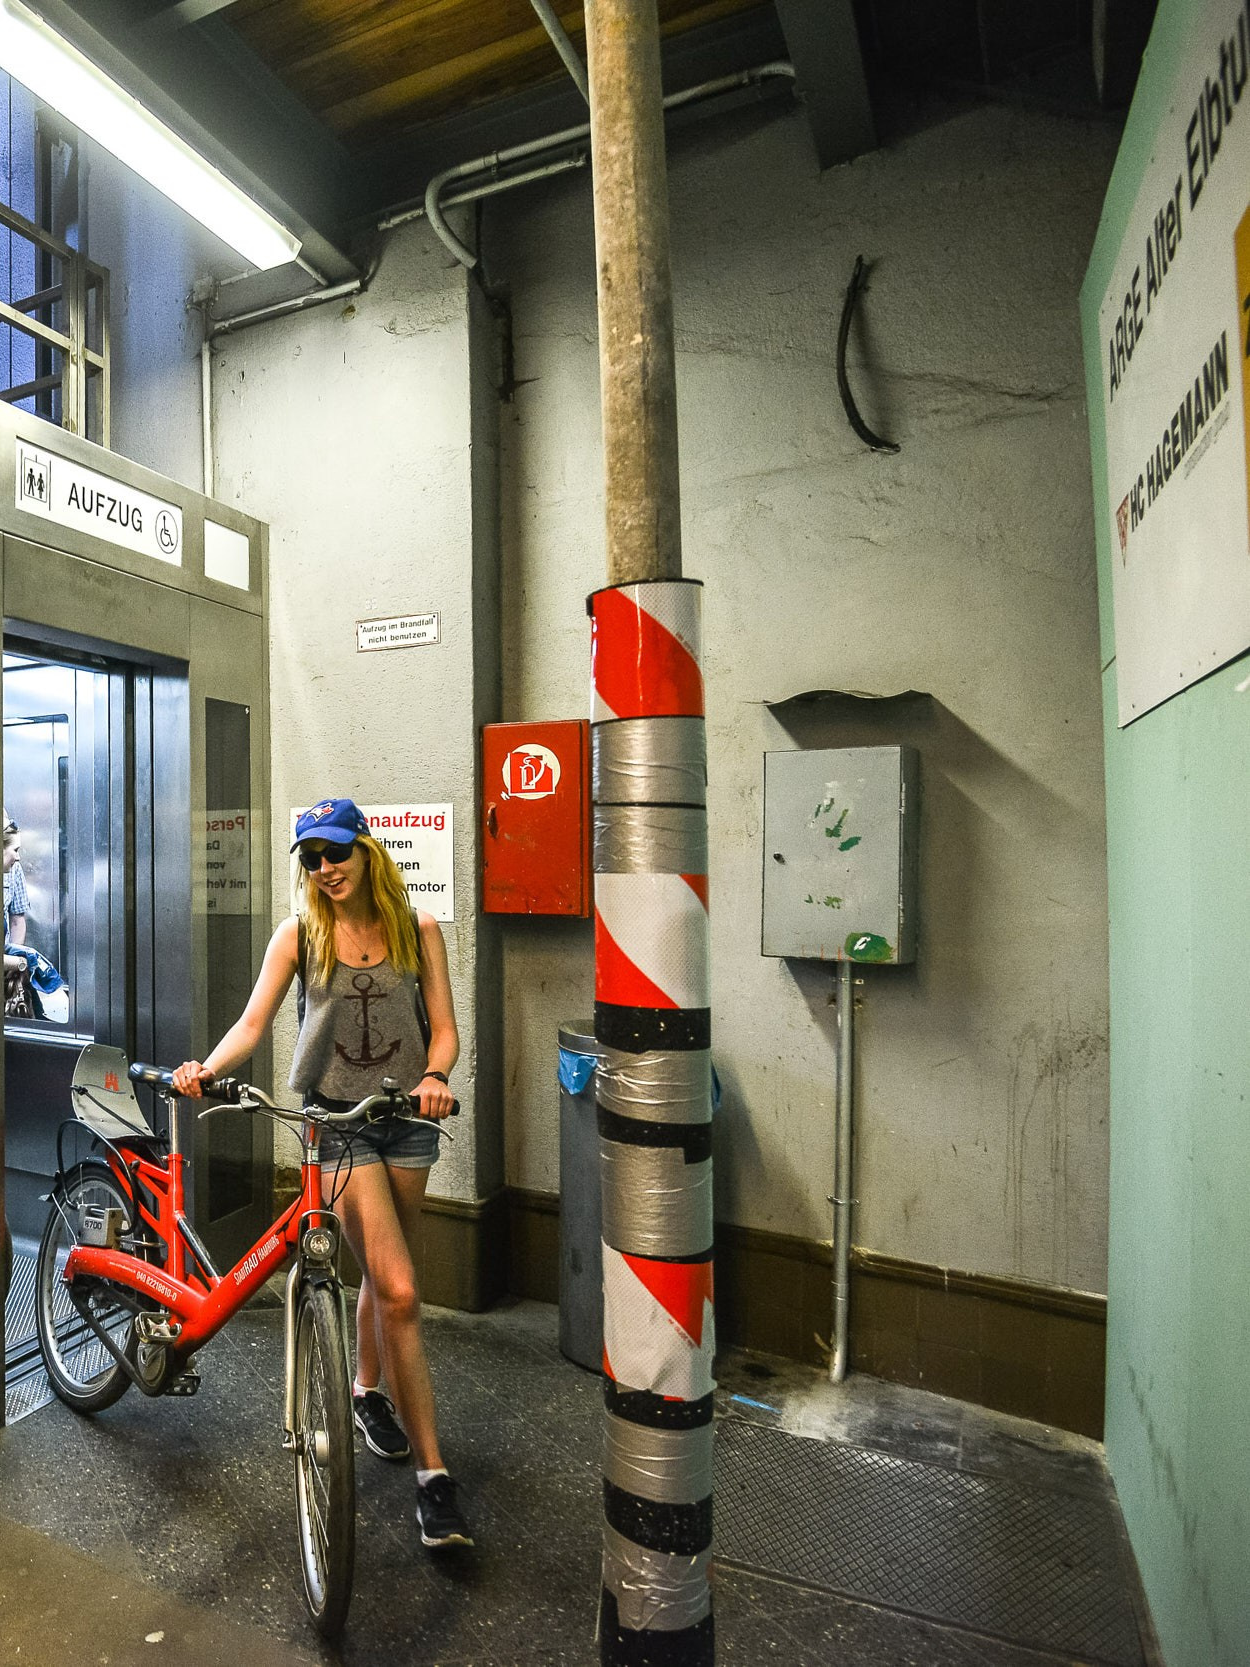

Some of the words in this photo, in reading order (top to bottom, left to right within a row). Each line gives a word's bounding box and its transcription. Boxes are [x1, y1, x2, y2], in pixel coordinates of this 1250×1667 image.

[1110, 265, 1143, 403] ARGE
[1147, 174, 1182, 316] Alter
[1186, 12, 1250, 212] Elbtu
[1130, 473, 1145, 533] HC
[1147, 330, 1229, 508] HAGEMANN
[68, 482, 143, 533] AUFZUG
[362, 624, 387, 633] Aufzug
[400, 618, 434, 629] Brandfall
[368, 635, 387, 644] nicht
[390, 631, 427, 641] benutzen
[364, 812, 445, 831] naufzug
[396, 861, 420, 873] gen
[406, 881, 446, 893] motor
